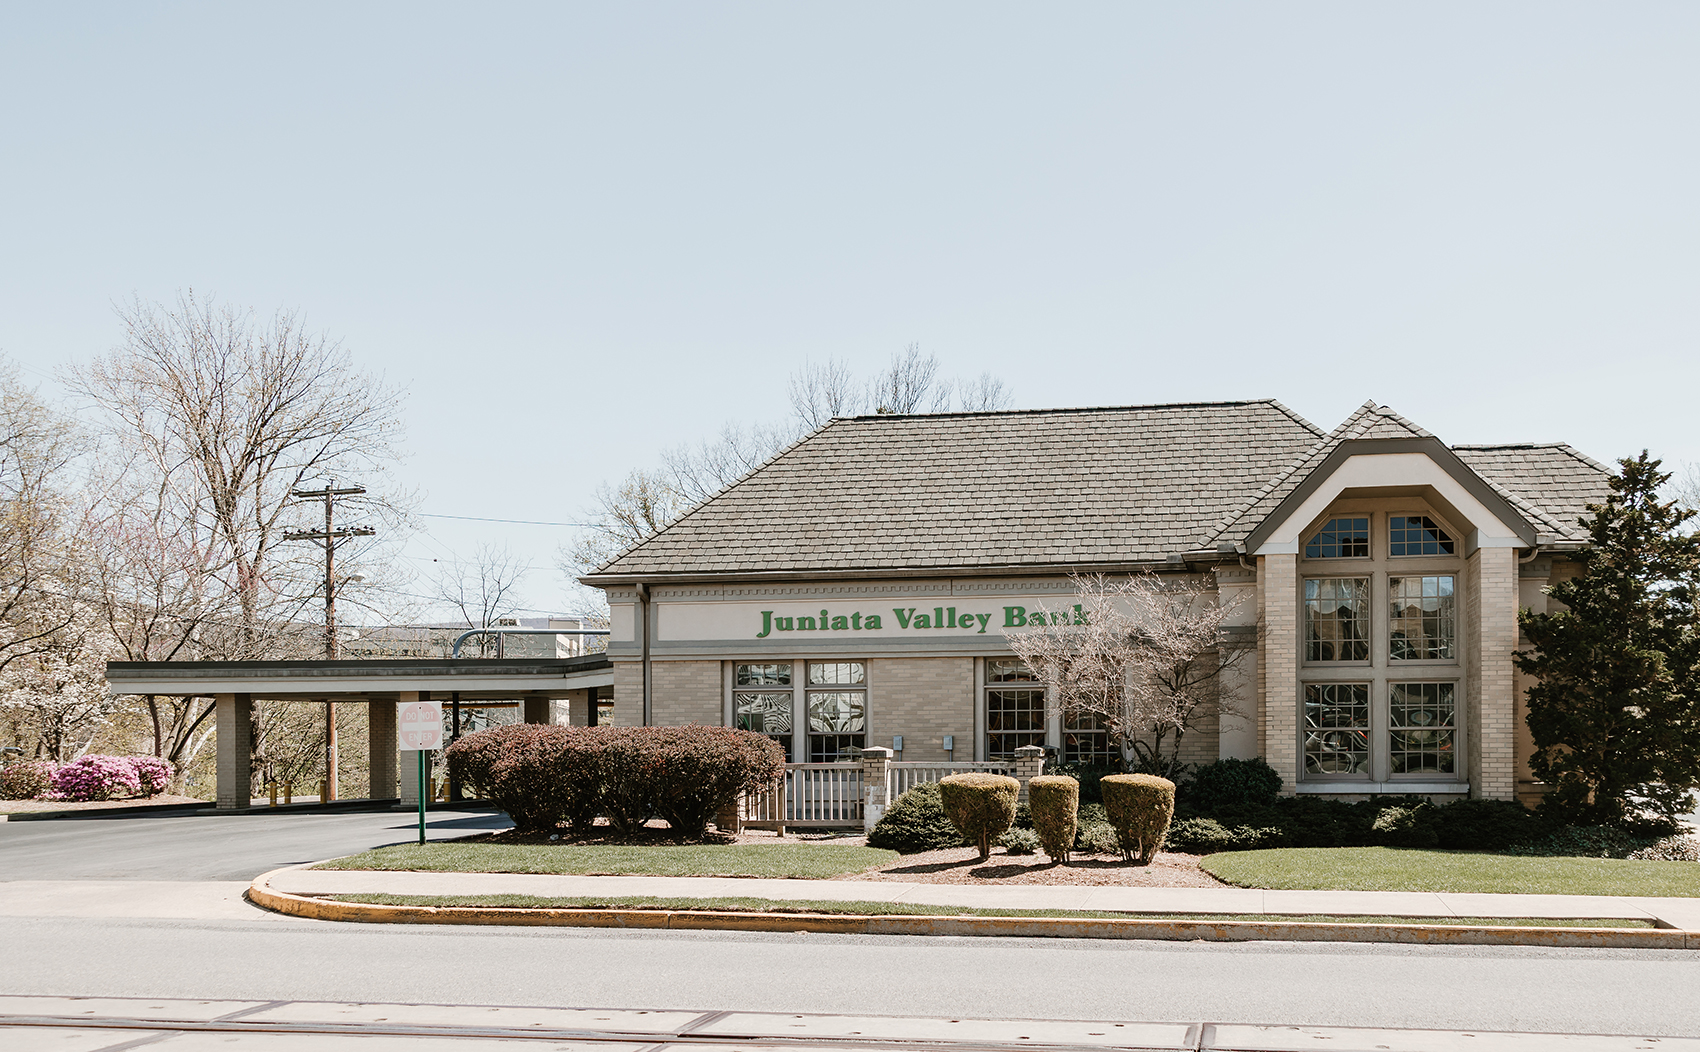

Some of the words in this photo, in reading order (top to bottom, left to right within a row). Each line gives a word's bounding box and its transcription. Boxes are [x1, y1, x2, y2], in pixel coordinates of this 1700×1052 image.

[756, 609, 883, 638] Juniata
[892, 607, 992, 633] Valley
[406, 712, 417, 721] DO
